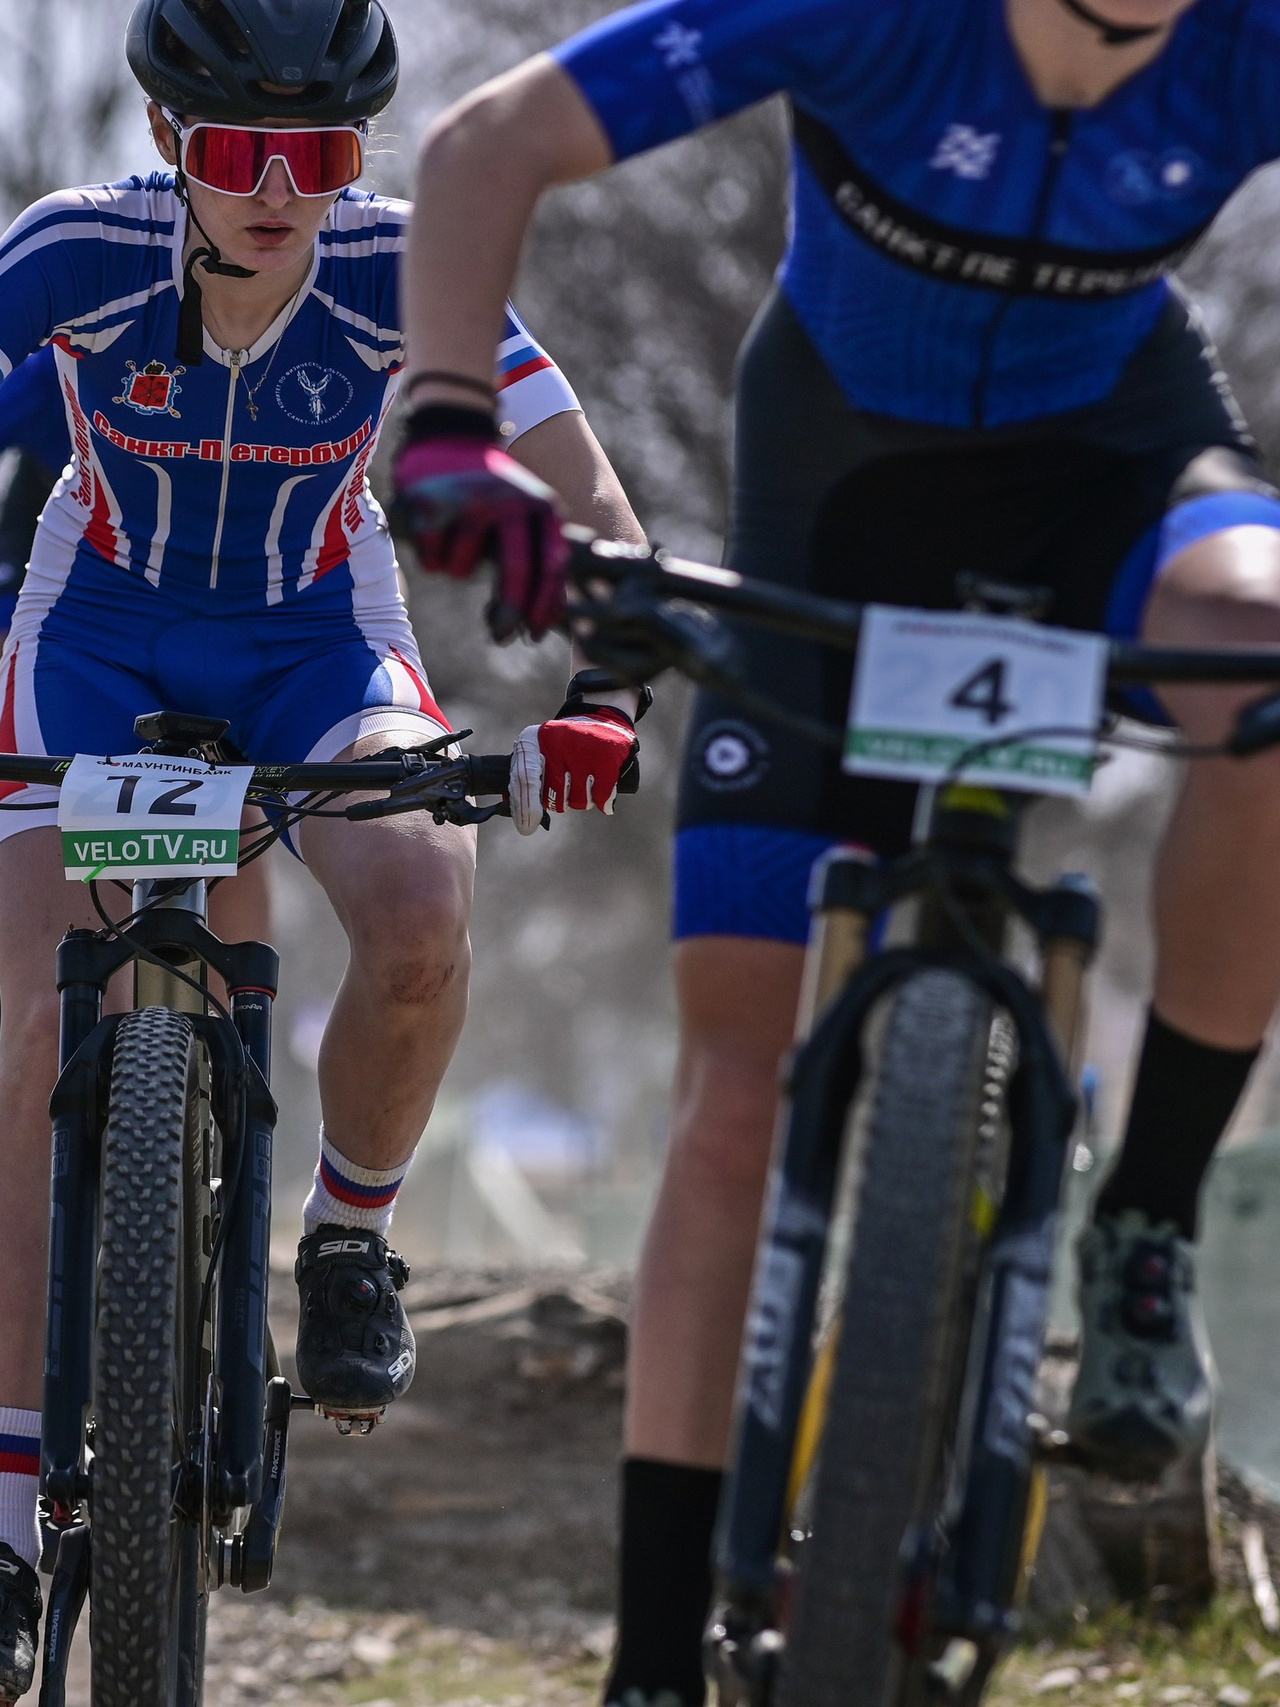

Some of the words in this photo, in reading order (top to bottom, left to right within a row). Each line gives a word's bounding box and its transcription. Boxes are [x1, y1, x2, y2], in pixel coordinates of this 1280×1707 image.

[950, 657, 1015, 727] 4
[106, 775, 204, 816] 12
[74, 834, 227, 862] VELOTV.RU
